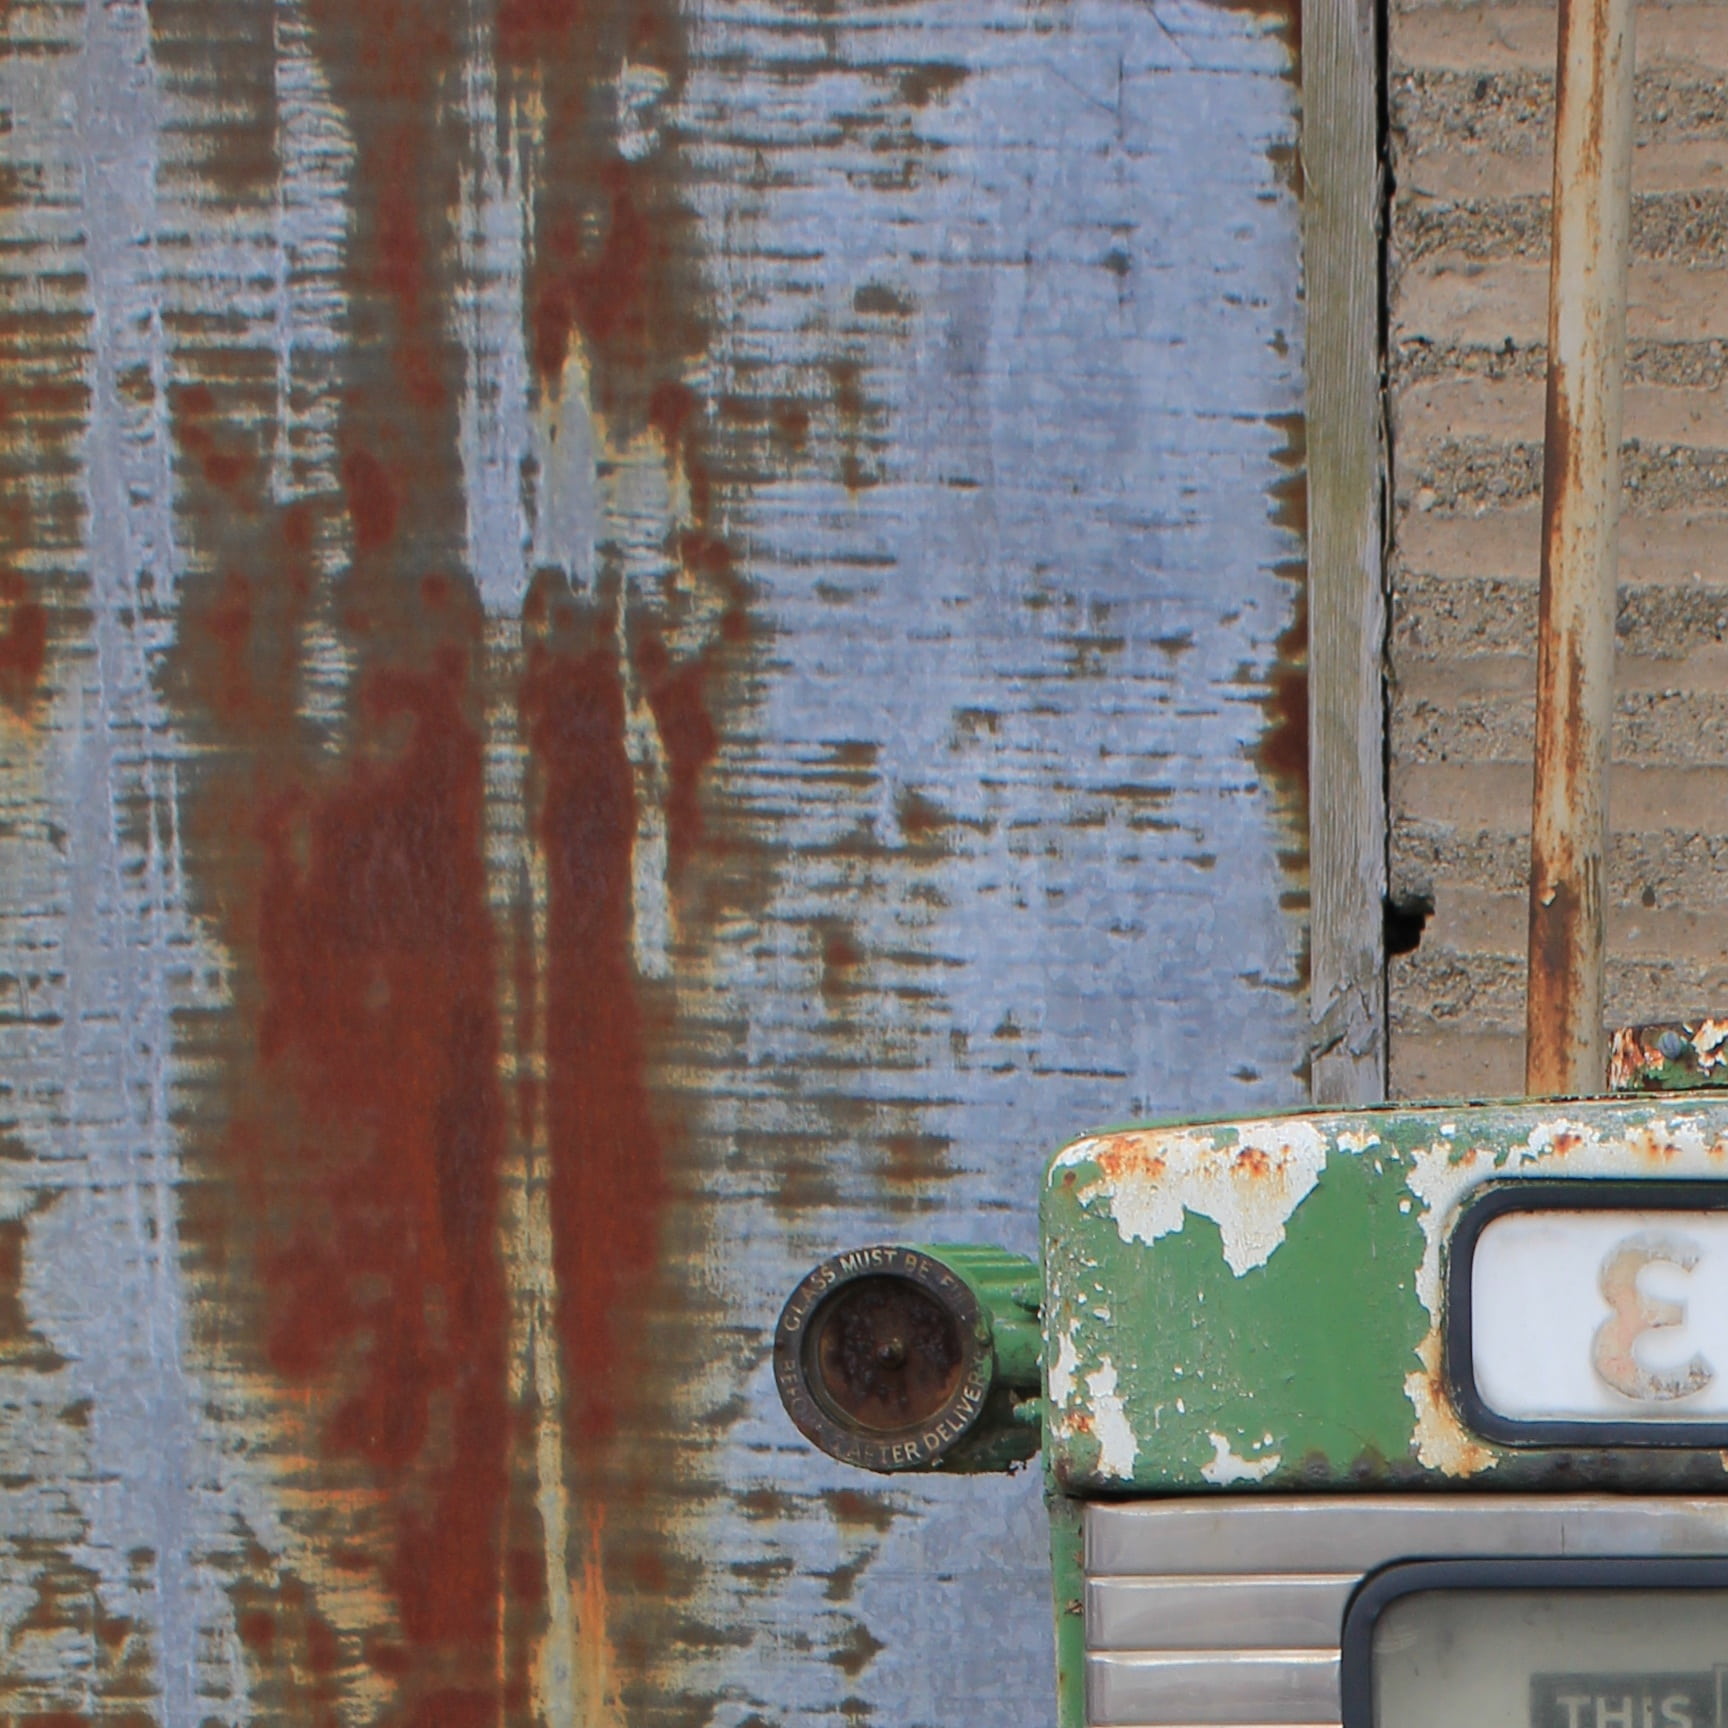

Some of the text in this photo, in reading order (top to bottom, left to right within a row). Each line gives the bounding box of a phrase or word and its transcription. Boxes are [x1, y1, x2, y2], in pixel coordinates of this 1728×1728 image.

[783, 1265, 836, 1332] GLASS
[840, 1249, 898, 1273] MUST
[905, 1255, 930, 1279] BE
